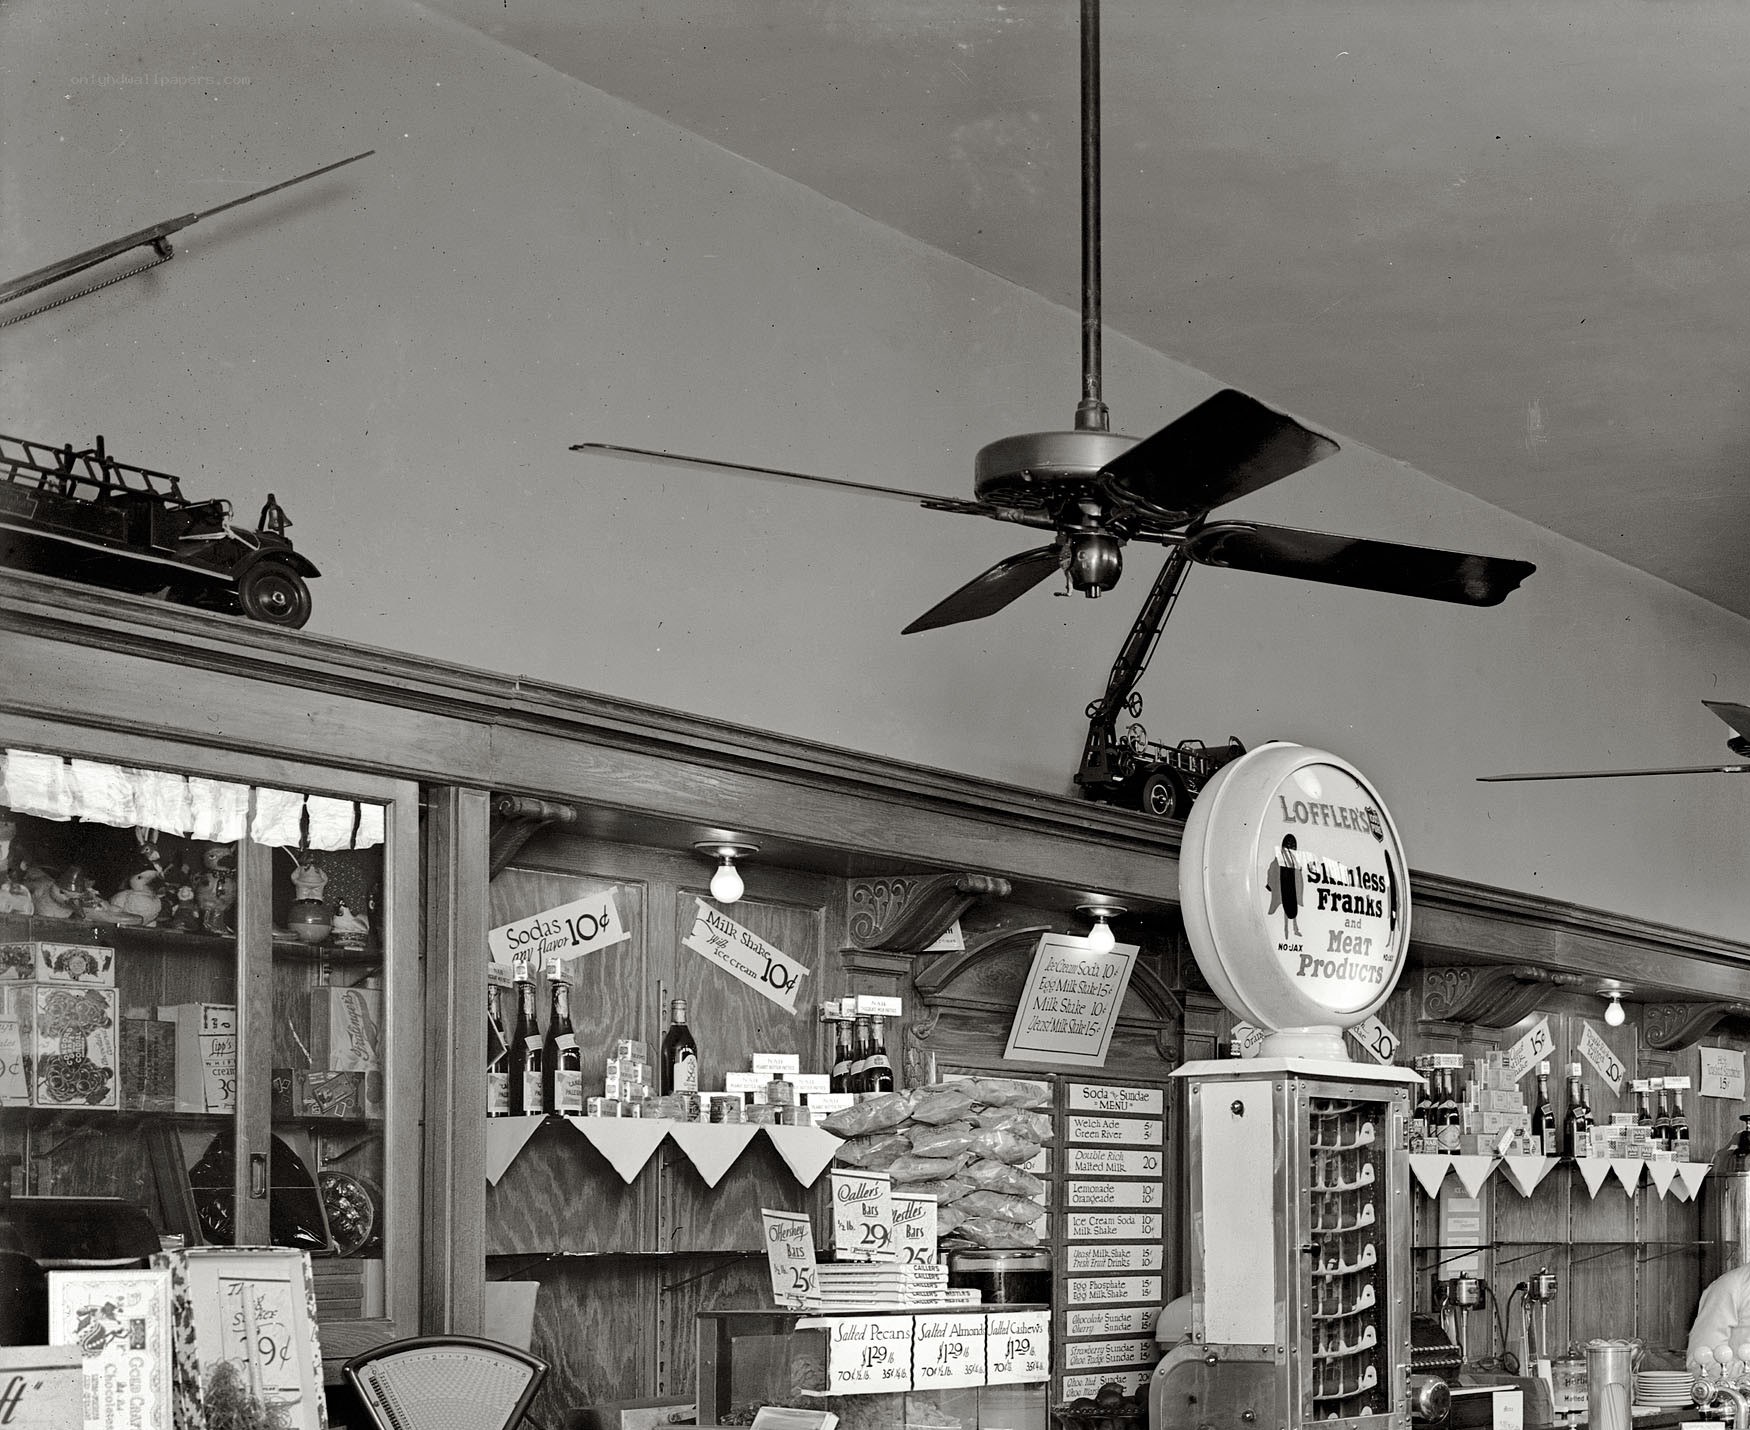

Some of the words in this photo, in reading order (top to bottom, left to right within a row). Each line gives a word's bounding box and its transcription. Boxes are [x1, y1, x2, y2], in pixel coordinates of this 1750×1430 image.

[1279, 794, 1370, 833] LOFFLER'S
[1316, 888, 1383, 918] Franks
[506, 917, 562, 950] Sodas
[565, 905, 609, 946] 10¢
[1345, 918, 1362, 929] and
[537, 936, 569, 972] flavor
[706, 910, 739, 939] Milk
[740, 932, 771, 959] Shake
[761, 958, 797, 994] 10¢
[713, 948, 730, 965] ice
[730, 957, 758, 979] cream
[1078, 961, 1099, 978] Soda
[1039, 976, 1057, 994] Egg
[1057, 979, 1077, 994] Milk
[1078, 981, 1098, 996] Shake
[1033, 996, 1058, 1012] Milk
[1060, 998, 1086, 1015] Shake
[1052, 1019, 1067, 1033] Milk
[1067, 1020, 1085, 1035] Shake
[1083, 1087, 1108, 1099] Soda
[1119, 1090, 1150, 1102] Sundae
[1074, 1119, 1101, 1128] Welch
[1102, 1120, 1120, 1129] Ade
[1075, 1129, 1100, 1138] Green
[1101, 1130, 1123, 1139] River
[1075, 1151, 1105, 1160] Double
[1107, 1152, 1124, 1161] Rich
[1075, 1162, 1104, 1171] Malted
[1106, 1163, 1127, 1172] Milk
[1073, 1184, 1115, 1193] Lemonade
[1073, 1195, 1115, 1205] Orangeade
[862, 1202, 879, 1216] Bars
[1073, 1217, 1086, 1226] Ice
[1089, 1217, 1115, 1225] Cream
[1117, 1216, 1135, 1225] Soda
[769, 1221, 808, 1242] Hershey
[906, 1223, 924, 1238] Bars
[1073, 1227, 1092, 1236] Milk
[1093, 1226, 1117, 1235] Shake
[787, 1243, 805, 1257] Bars
[1092, 1249, 1110, 1258] Milk
[1111, 1249, 1131, 1258] Shake
[1107, 1258, 1130, 1267] Drinks
[790, 1266, 815, 1292] 25¢
[1073, 1282, 1087, 1292] Egg
[1089, 1280, 1126, 1292] Phosphate
[1073, 1292, 1087, 1301] Egg
[1089, 1290, 1107, 1299] Milk
[1107, 1290, 1128, 1299] Shake
[1072, 1314, 1103, 1325] Chocolate
[1105, 1312, 1132, 1322] Sundae
[834, 1323, 867, 1342] Salted
[871, 1324, 911, 1341] Pecans
[918, 1322, 947, 1341] Salted
[987, 1320, 1009, 1337] Salted
[1010, 1321, 1043, 1335] Cashews
[1104, 1323, 1132, 1332] Sundae
[1106, 1344, 1134, 1353] Sundae
[1106, 1354, 1134, 1363] Sundae
[104, 1363, 117, 1430] Chocolates
